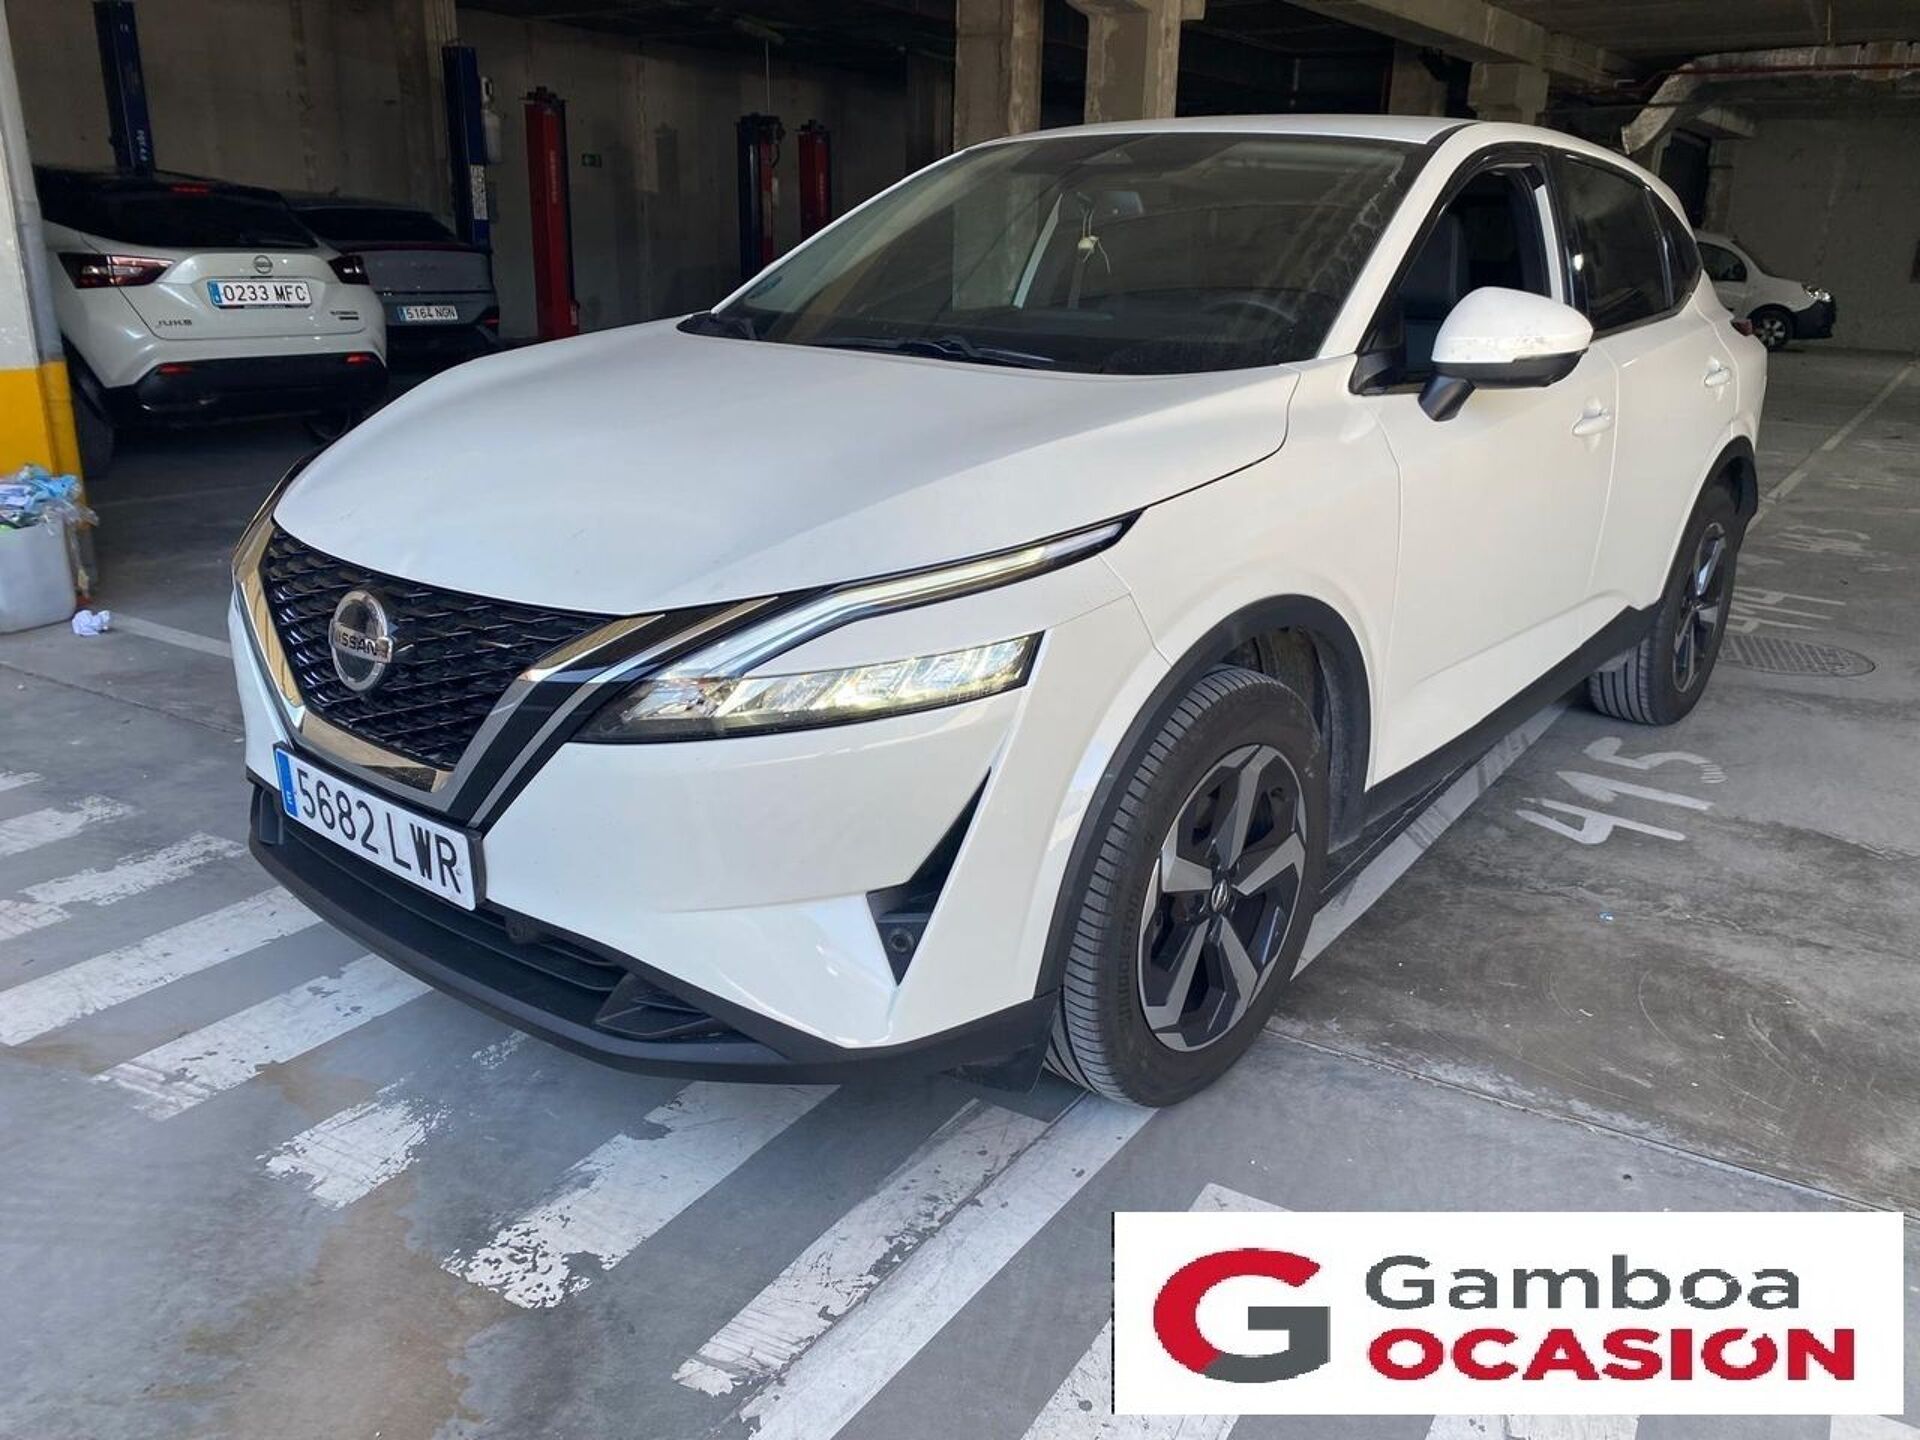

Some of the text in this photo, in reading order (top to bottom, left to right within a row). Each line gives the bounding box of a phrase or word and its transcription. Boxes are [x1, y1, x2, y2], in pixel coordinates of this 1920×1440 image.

[223, 284, 307, 302] 0233 MFC
[407, 306, 433, 319] 5164
[1514, 736, 1728, 845] 415
[296, 767, 379, 855] 5682
[386, 811, 461, 894] LWR
